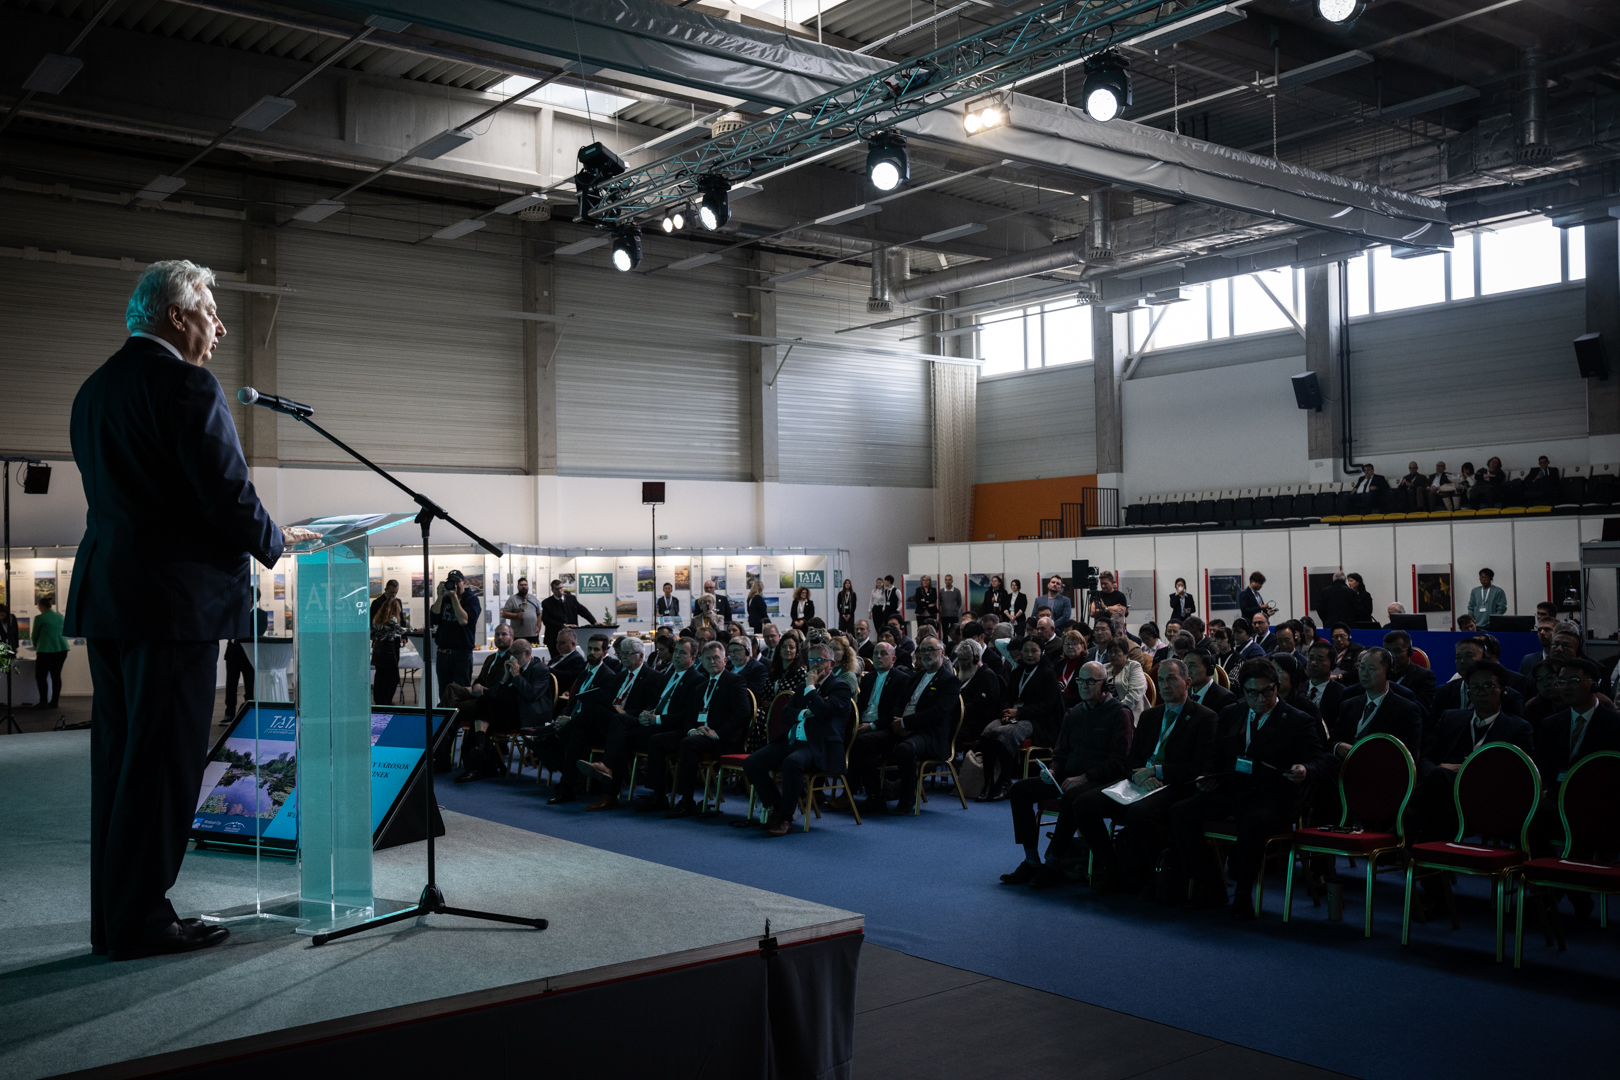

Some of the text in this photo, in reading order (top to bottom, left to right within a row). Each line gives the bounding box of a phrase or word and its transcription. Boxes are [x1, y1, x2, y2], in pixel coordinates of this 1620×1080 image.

[581, 575, 610, 587] TATA
[798, 572, 822, 583] TATA
[378, 761, 410, 770] VÁROSOK
